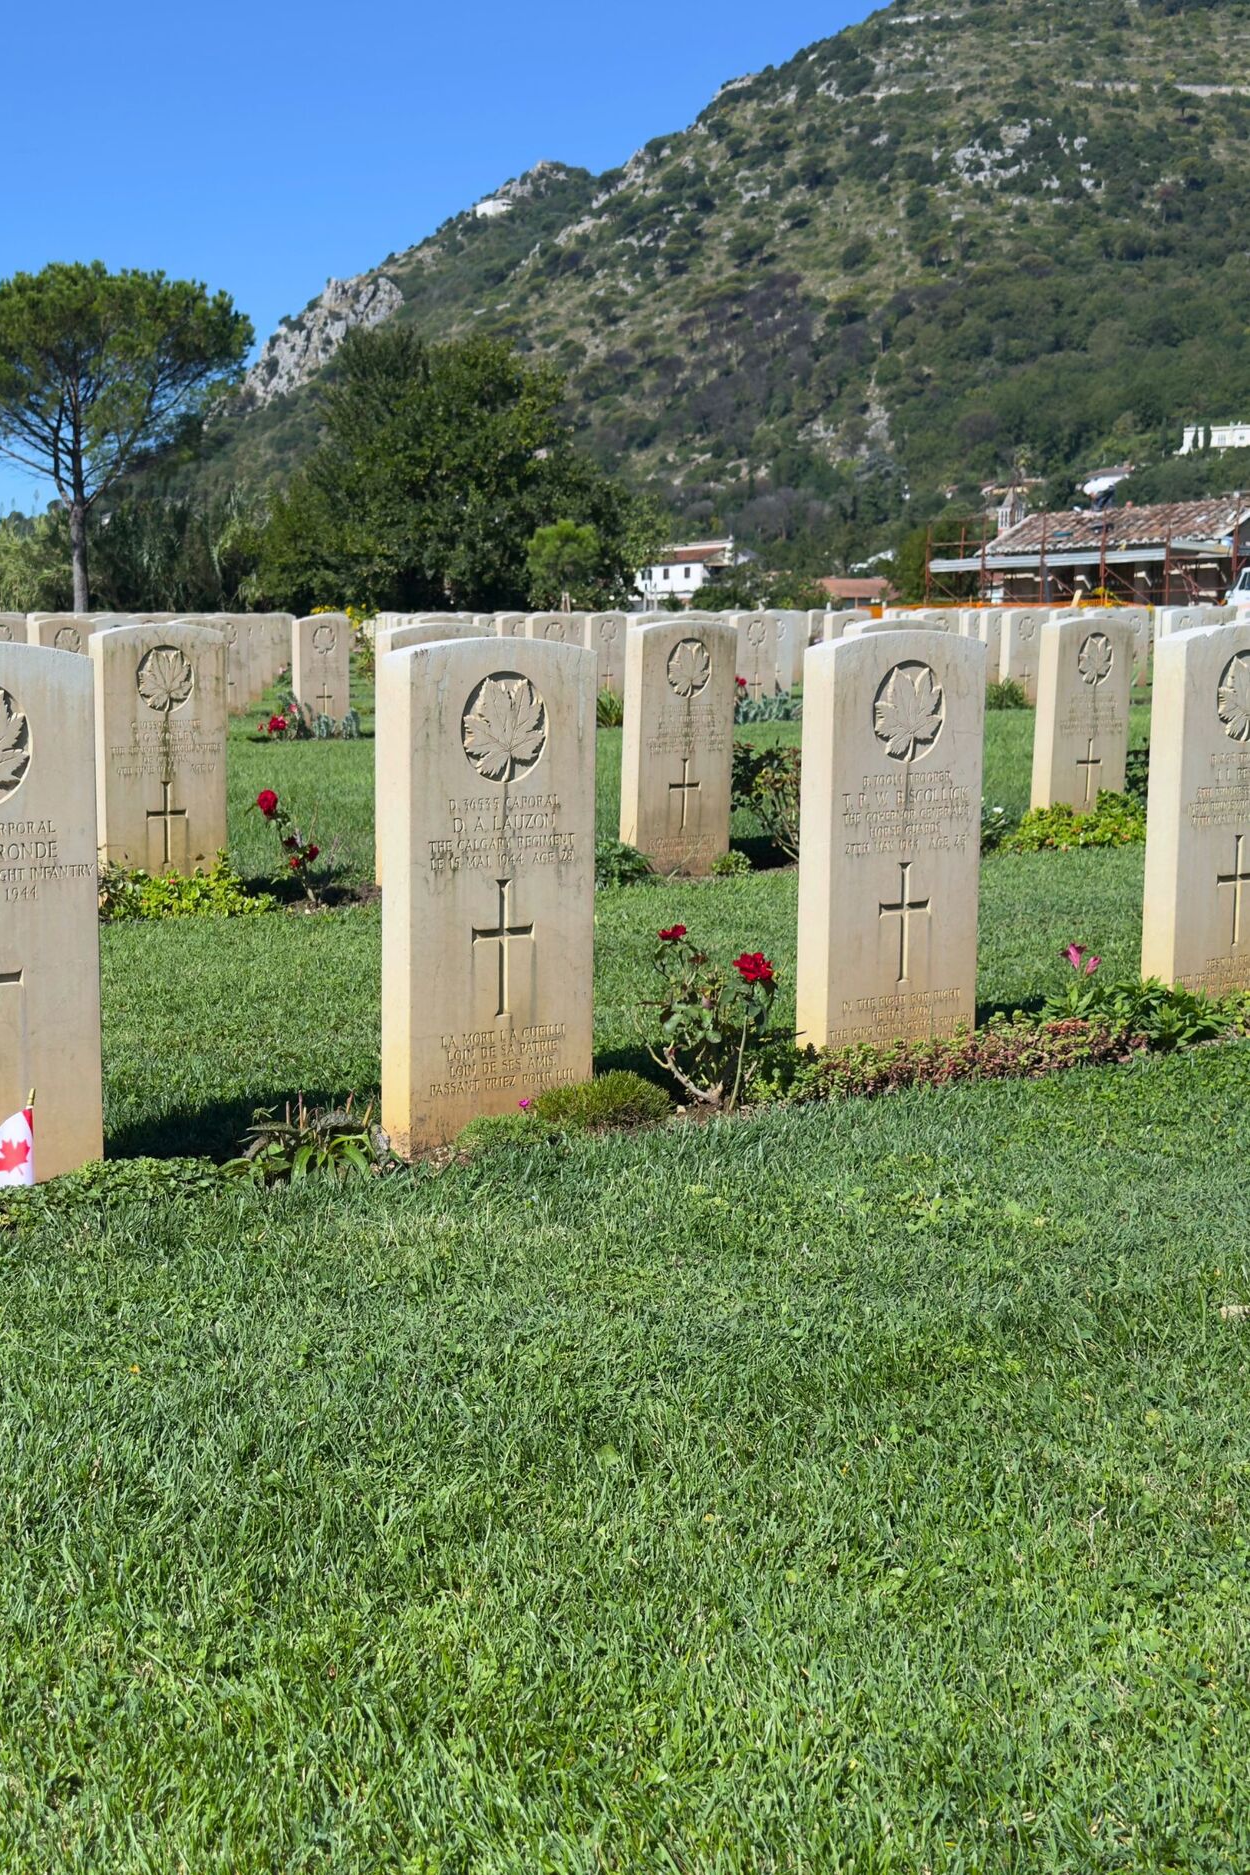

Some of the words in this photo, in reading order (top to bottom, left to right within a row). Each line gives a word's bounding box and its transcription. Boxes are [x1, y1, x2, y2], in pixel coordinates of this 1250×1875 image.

[907, 771, 951, 784] TROOPER
[505, 794, 560, 811] CAPORAL
[493, 813, 556, 831] LAUZON
[842, 813, 861, 825] THE
[428, 840, 452, 853] THE
[457, 836, 512, 851] CALGARY
[517, 833, 575, 848] REGIMENT
[431, 858, 444, 870] LE
[498, 853, 524, 866] 1944
[30, 864, 95, 880] INFANTRY
[5, 885, 39, 904] 1944
[441, 1036, 456, 1048] LA
[463, 1031, 495, 1046] MORT
[830, 1030, 849, 1040] THE
[852, 1026, 874, 1038] KING
[447, 1048, 475, 1062] LOIN
[481, 1046, 496, 1058] DE
[501, 1043, 515, 1055] SA
[520, 1040, 559, 1054] PATRIE
[450, 1064, 476, 1078] LOIN
[483, 1062, 496, 1074] DE
[502, 1058, 521, 1071] SES
[485, 1076, 516, 1090] PRIEZ
[522, 1072, 552, 1084] POUR
